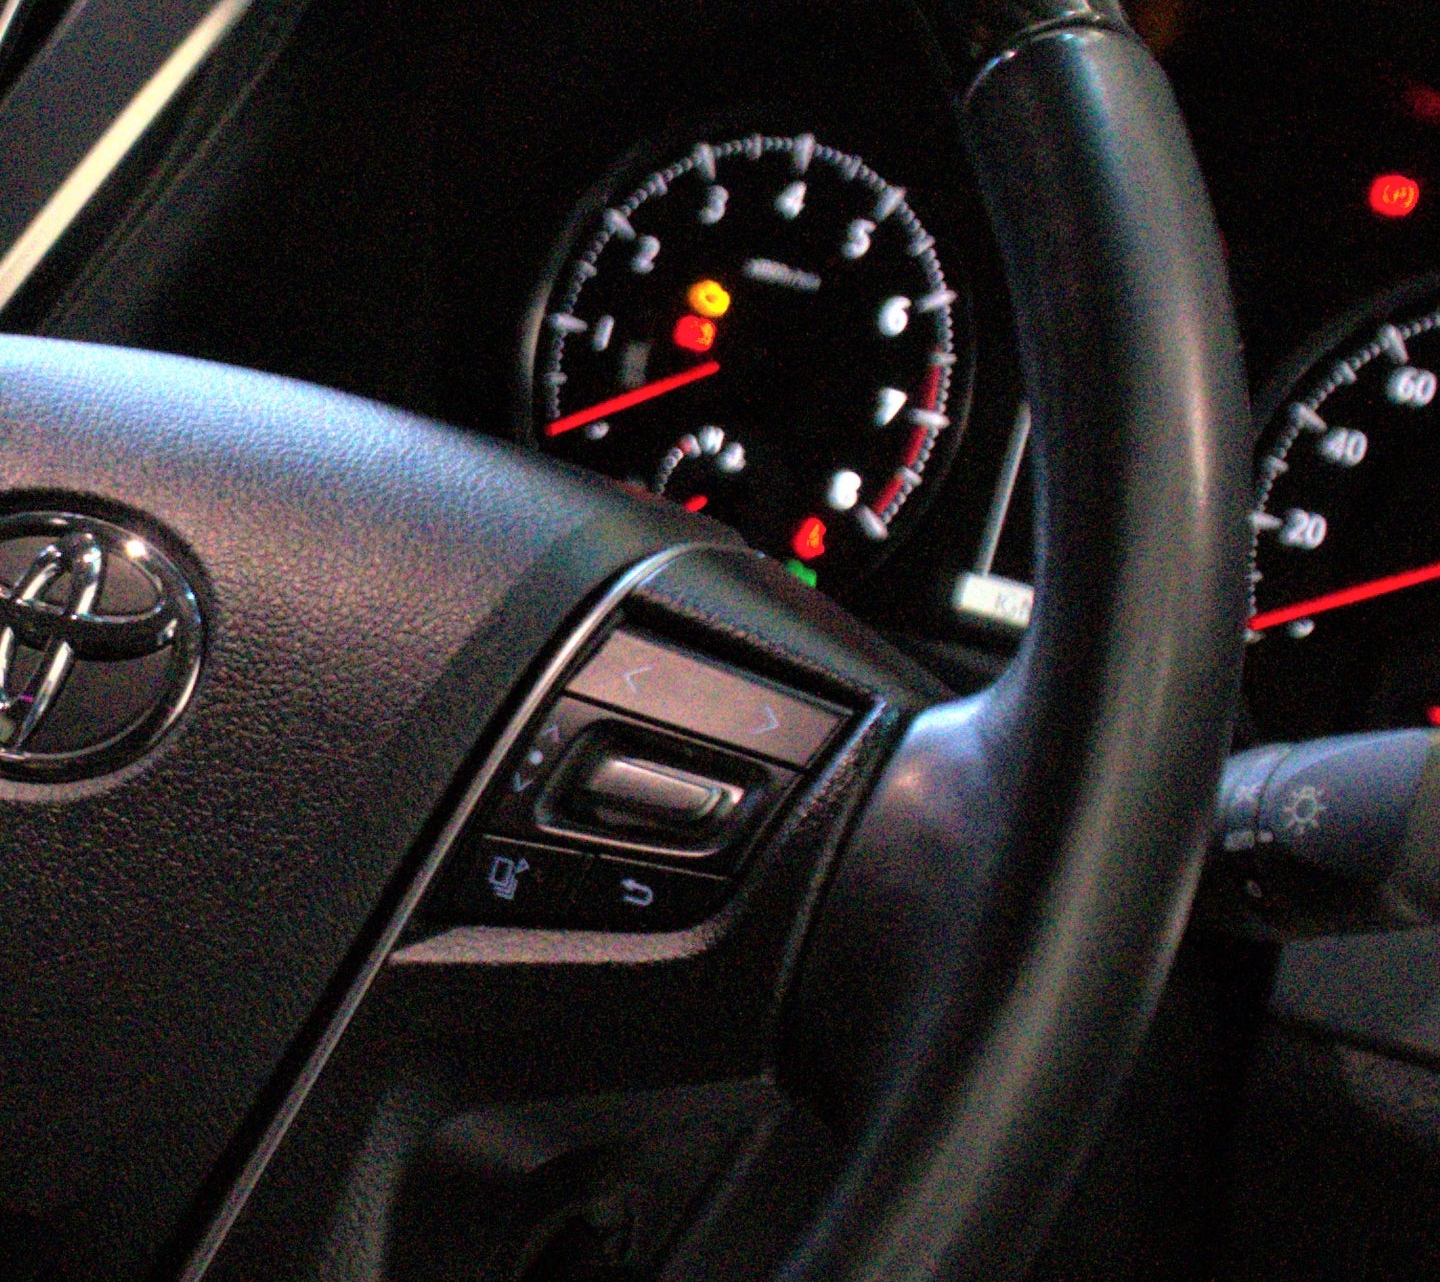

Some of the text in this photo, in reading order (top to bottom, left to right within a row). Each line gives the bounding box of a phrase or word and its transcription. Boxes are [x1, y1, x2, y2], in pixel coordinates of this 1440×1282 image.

[842, 219, 877, 259] 5
[878, 295, 911, 337] 6
[1387, 367, 1438, 407] 60
[1320, 428, 1368, 467] 40
[1280, 508, 1327, 550] 20
